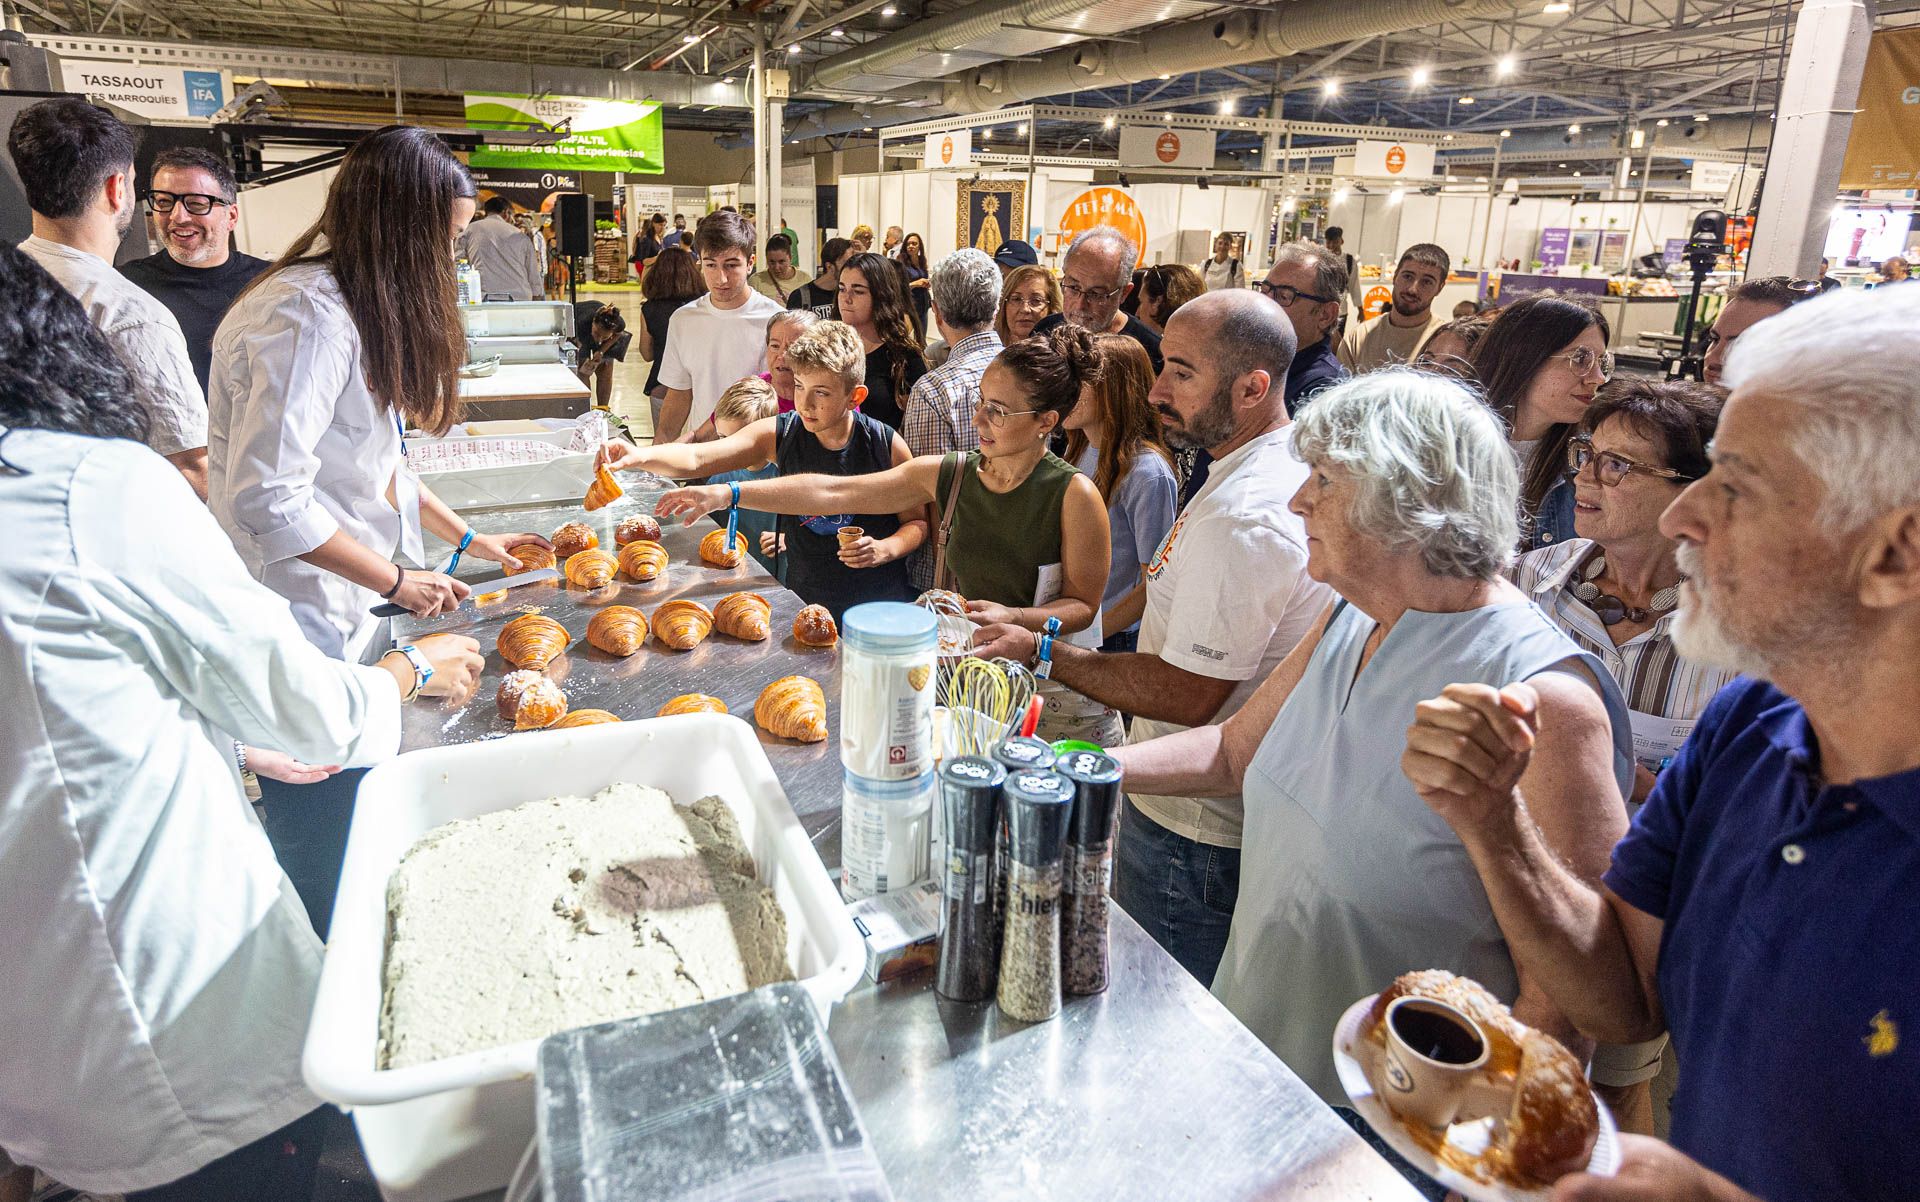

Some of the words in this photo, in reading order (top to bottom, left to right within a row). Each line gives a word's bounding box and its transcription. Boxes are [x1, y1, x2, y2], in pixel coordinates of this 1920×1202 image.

[81, 74, 164, 90] TASSAOUT
[193, 89, 216, 102] IFA
[576, 145, 645, 159] Experiencias
[815, 305, 834, 320] STR
[1018, 775, 1060, 790] 100
